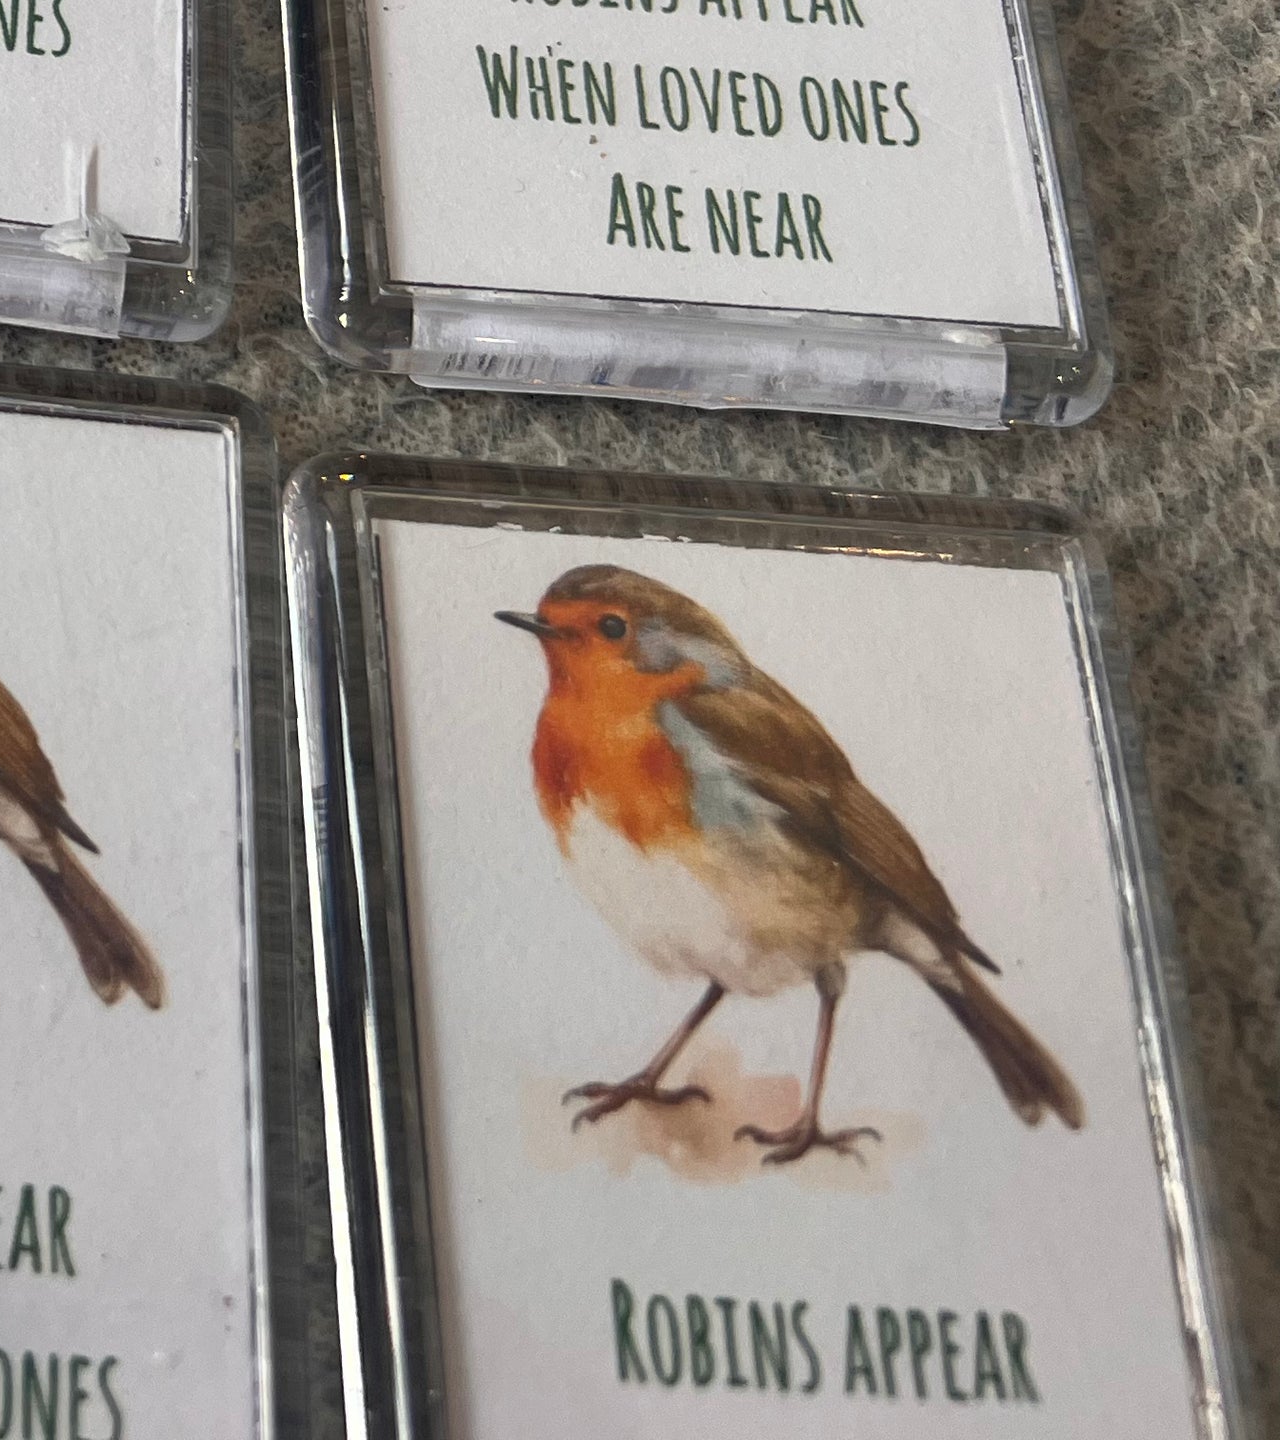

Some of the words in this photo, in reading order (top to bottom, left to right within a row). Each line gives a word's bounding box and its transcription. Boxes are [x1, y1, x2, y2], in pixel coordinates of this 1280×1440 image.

[474, 43, 618, 128] WHEN
[632, 62, 785, 139] LOVED
[798, 74, 922, 149] ONES
[605, 170, 693, 255] ARE
[703, 186, 835, 265] NEAR
[609, 1276, 823, 1396] ROBINS
[843, 1303, 1041, 1405] APPEAR
